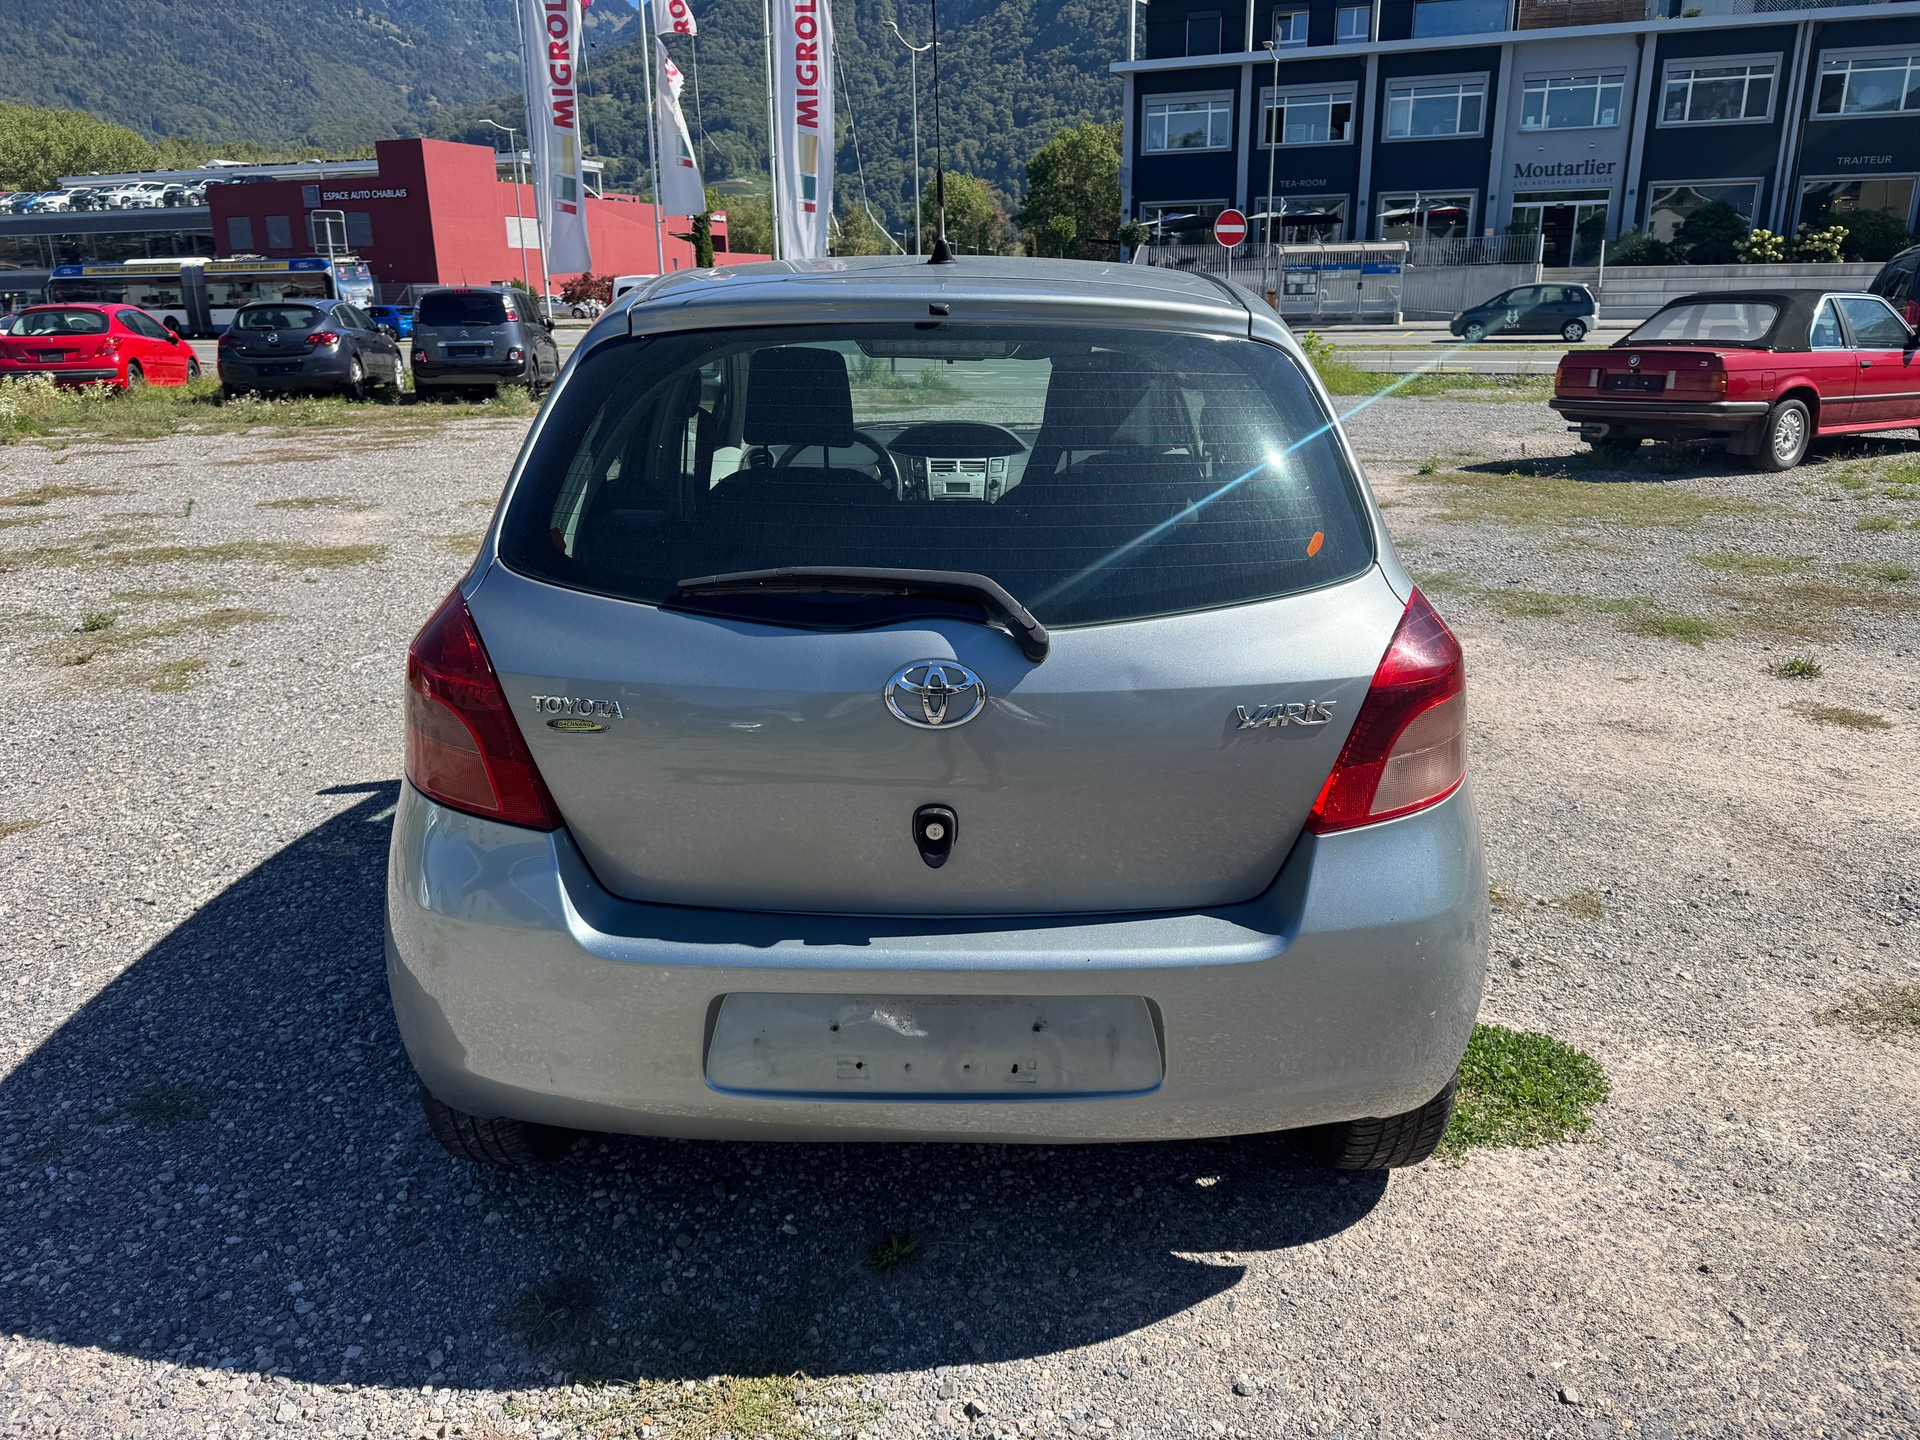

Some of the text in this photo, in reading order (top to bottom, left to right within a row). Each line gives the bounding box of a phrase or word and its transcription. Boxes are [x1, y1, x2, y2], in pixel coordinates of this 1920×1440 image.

[545, 0, 574, 129] MIGROL
[795, 0, 818, 129] MIGROL
[1513, 159, 1616, 178] Moutarlier
[1837, 155, 1893, 165] TRAITEUR
[1279, 178, 1327, 188] TEA-ROOM
[323, 188, 407, 200] ESPACE AUTO CHABLAIS
[532, 694, 624, 719] TOYOTA
